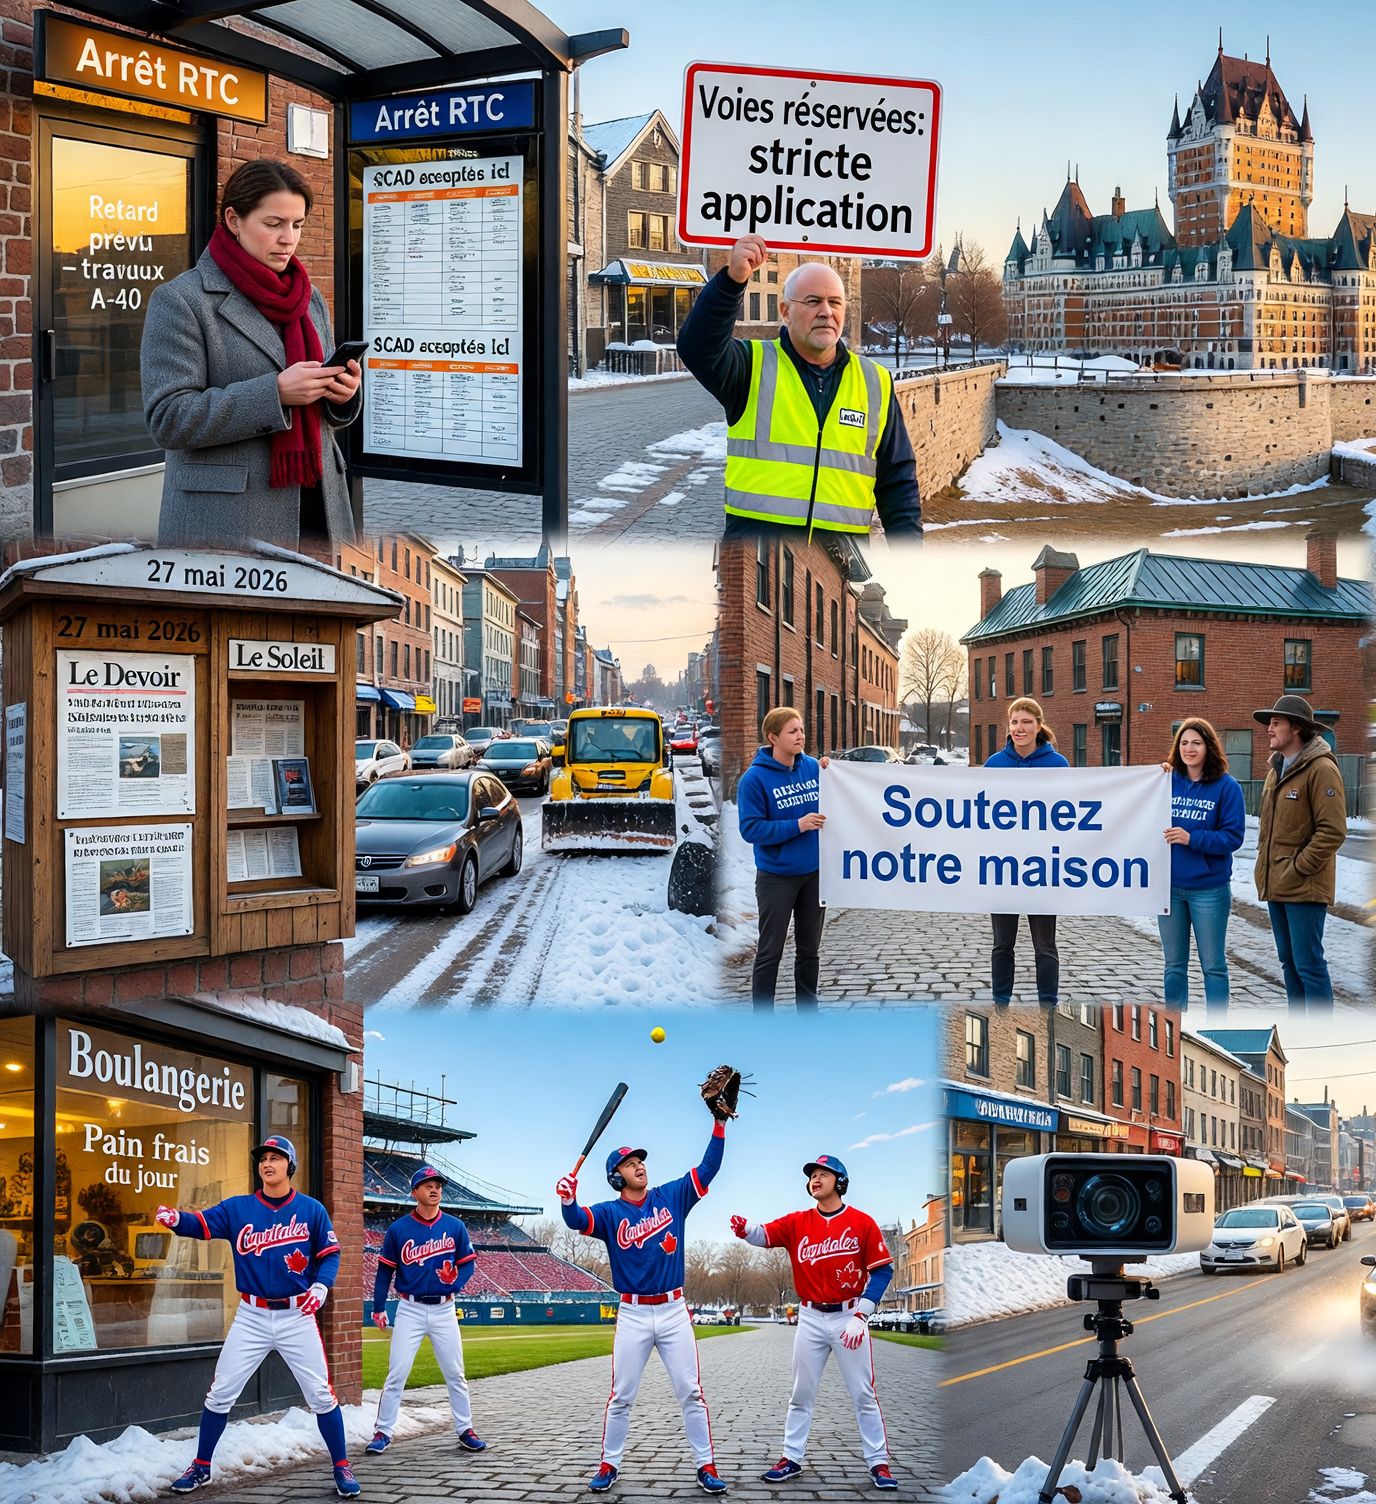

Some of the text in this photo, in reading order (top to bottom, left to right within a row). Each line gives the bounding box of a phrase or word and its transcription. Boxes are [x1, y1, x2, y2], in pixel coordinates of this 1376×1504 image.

[76, 38, 239, 105] Arrêt RTC
[375, 93, 505, 132] Arrêt RTC
[699, 84, 925, 136] Voies réservées:
[748, 138, 872, 181] stricte
[89, 194, 158, 222] Retard
[701, 184, 912, 234] application
[90, 288, 142, 310] A-40
[373, 336, 415, 353] SCAD
[147, 559, 288, 592] 27 mai 2026
[57, 615, 200, 642] 27 mai 2026
[68, 661, 181, 688] Le Devoir
[236, 643, 325, 670] Le Soleil
[882, 784, 1103, 832] Soutenez
[842, 843, 1149, 888] notre maison
[68, 1029, 245, 1113] Boulangerie
[83, 1123, 210, 1166] Pain frais
[105, 1161, 178, 1194] du jour
